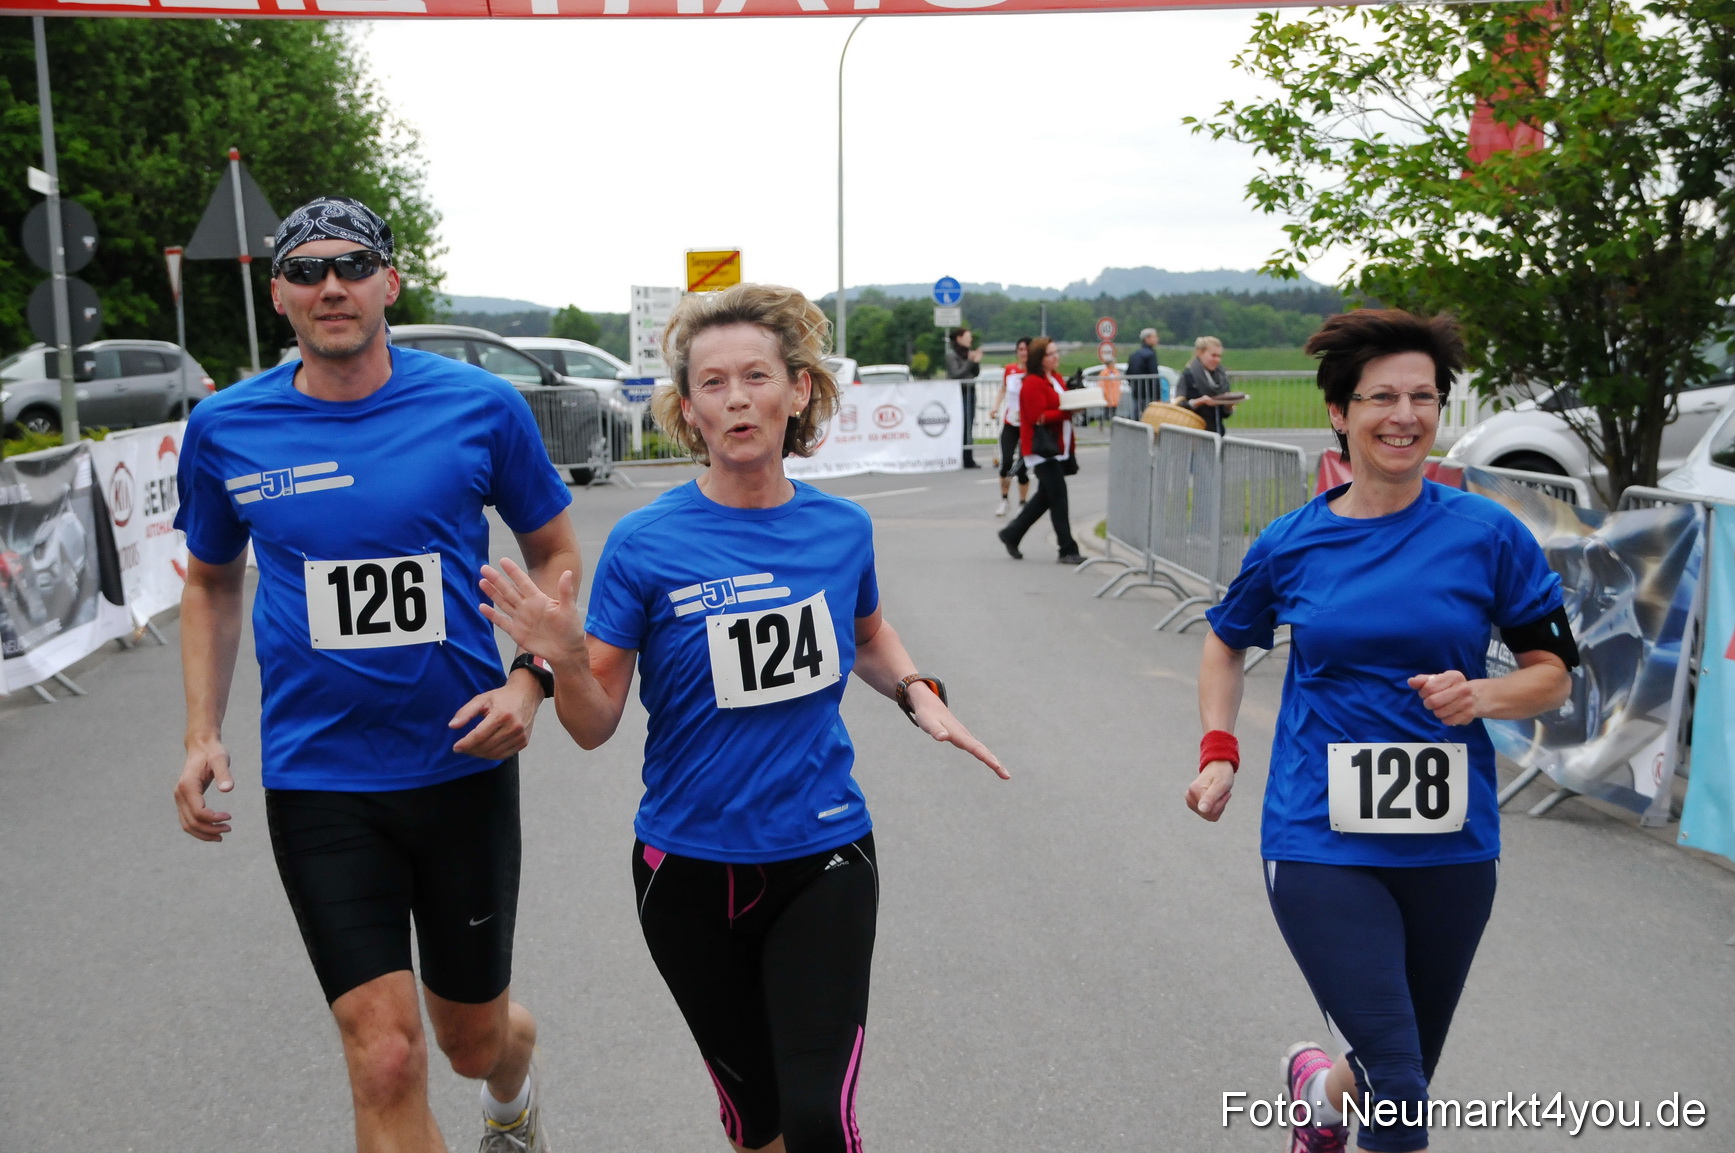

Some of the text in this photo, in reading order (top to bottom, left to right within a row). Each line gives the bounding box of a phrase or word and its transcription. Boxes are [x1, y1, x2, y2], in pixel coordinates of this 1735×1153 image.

[327, 560, 427, 636] 126
[728, 604, 823, 692] 124
[1351, 747, 1450, 820] 128
